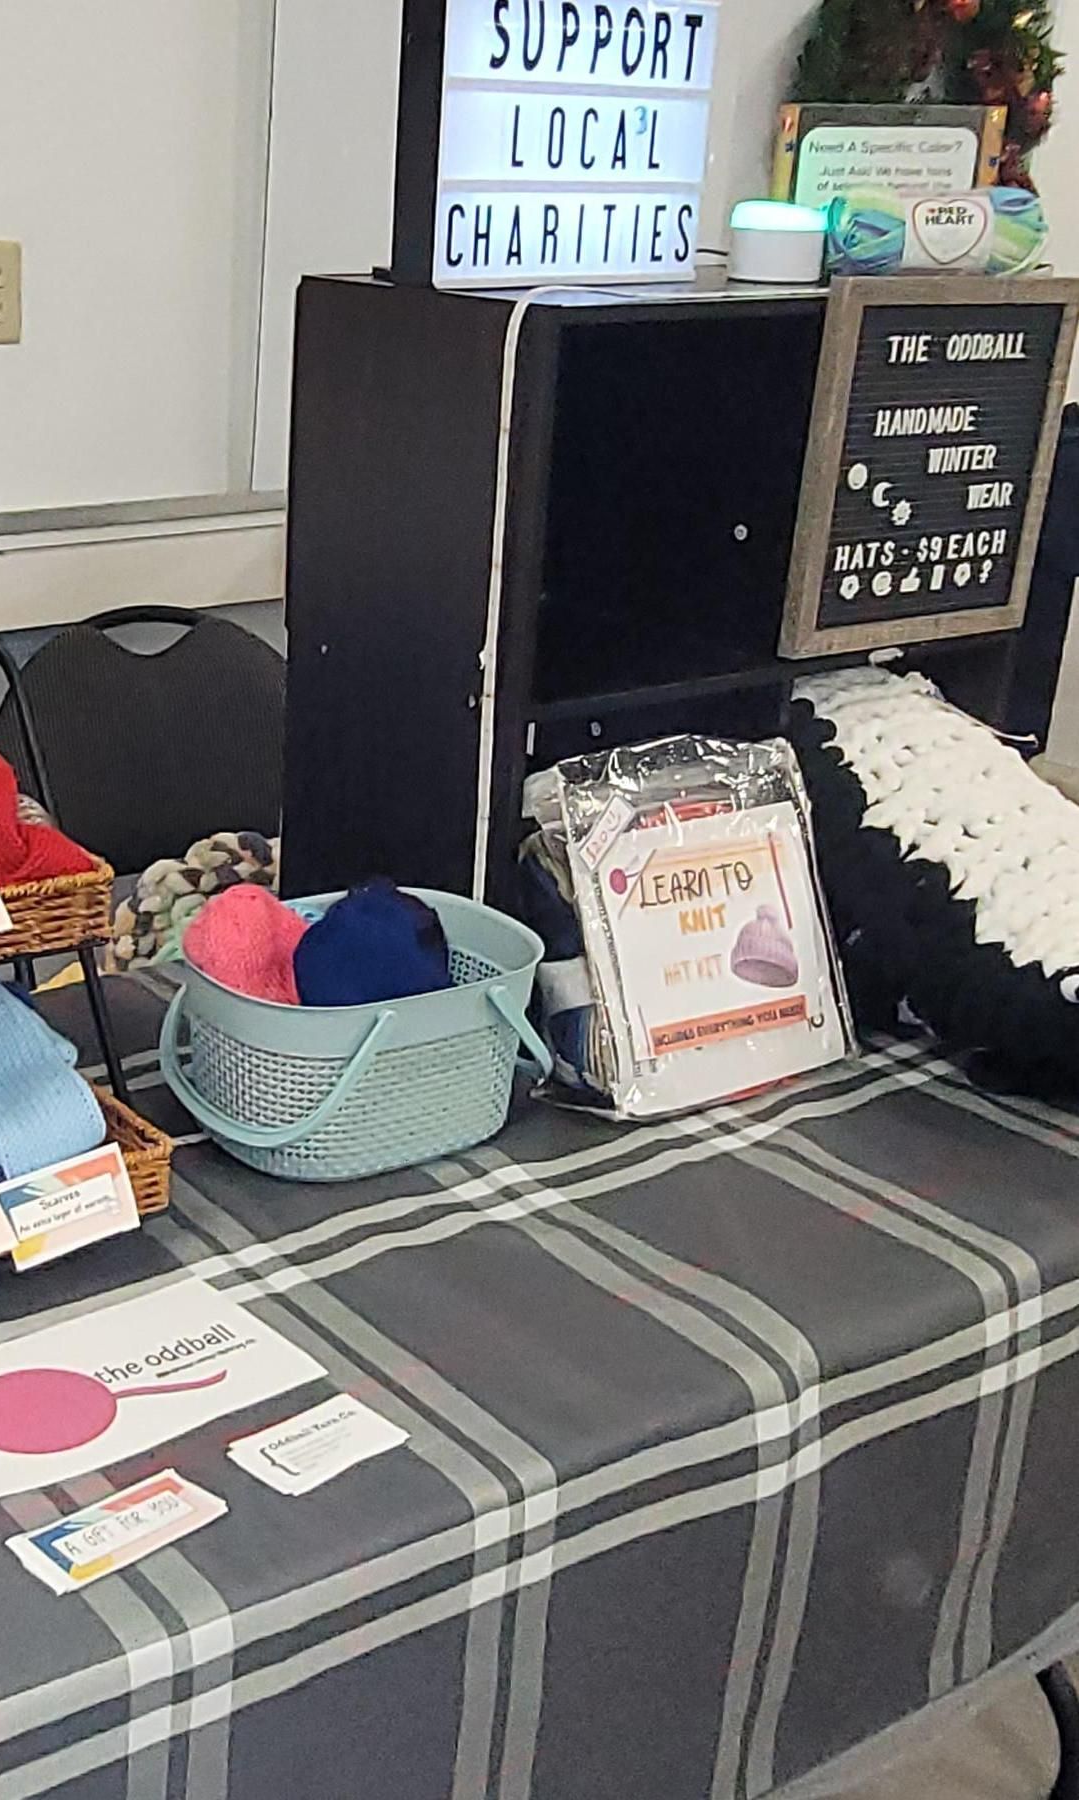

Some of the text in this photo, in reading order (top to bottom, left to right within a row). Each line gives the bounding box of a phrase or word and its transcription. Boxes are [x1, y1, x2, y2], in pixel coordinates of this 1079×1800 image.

[489, 0, 703, 82] SUPPORT
[511, 105, 660, 169] LOCAL
[446, 204, 693, 267] CHARITIES
[925, 214, 974, 225] HEART
[888, 333, 1026, 363] THE ODDBALL
[874, 406, 979, 437] HANDMADE
[927, 444, 997, 474] WINTER
[967, 482, 1013, 510] WEAR
[834, 540, 896, 572] HATS
[640, 861, 754, 909] LEARN TO
[679, 903, 726, 935] KNIT
[93, 1361, 143, 1384] the
[144, 1323, 237, 1367] oddball
